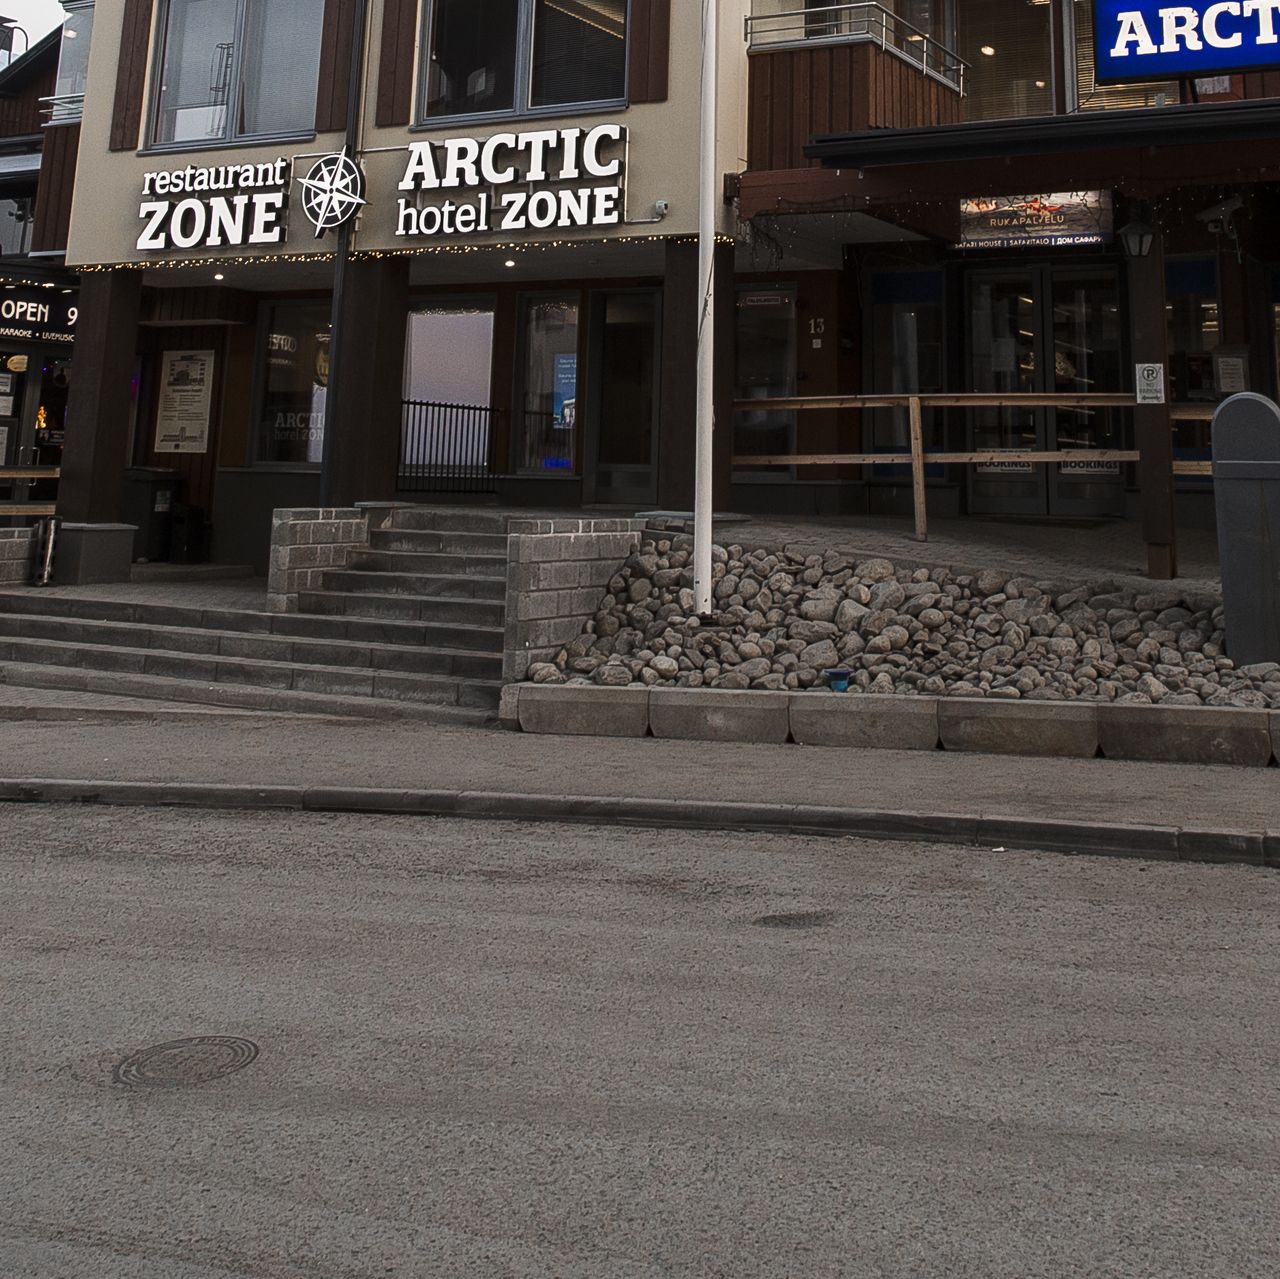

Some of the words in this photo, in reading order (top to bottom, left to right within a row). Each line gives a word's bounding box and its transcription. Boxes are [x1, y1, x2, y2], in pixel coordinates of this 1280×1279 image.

[397, 124, 622, 191] ARCTIC
[141, 157, 286, 195] restaurant
[395, 192, 489, 236] hotel
[500, 186, 619, 230] ZONE
[135, 192, 284, 250] ZONE
[978, 239, 1002, 247] HOUSE
[1, 299, 50, 323] OPEN
[0, 327, 33, 339] KARAOKE
[42, 331, 76, 342] LIVEMUSIC
[808, 317, 825, 335] 13
[274, 412, 325, 428] ARCTI
[301, 428, 324, 441] ZON
[1062, 460, 1118, 469] BOOKINGS
